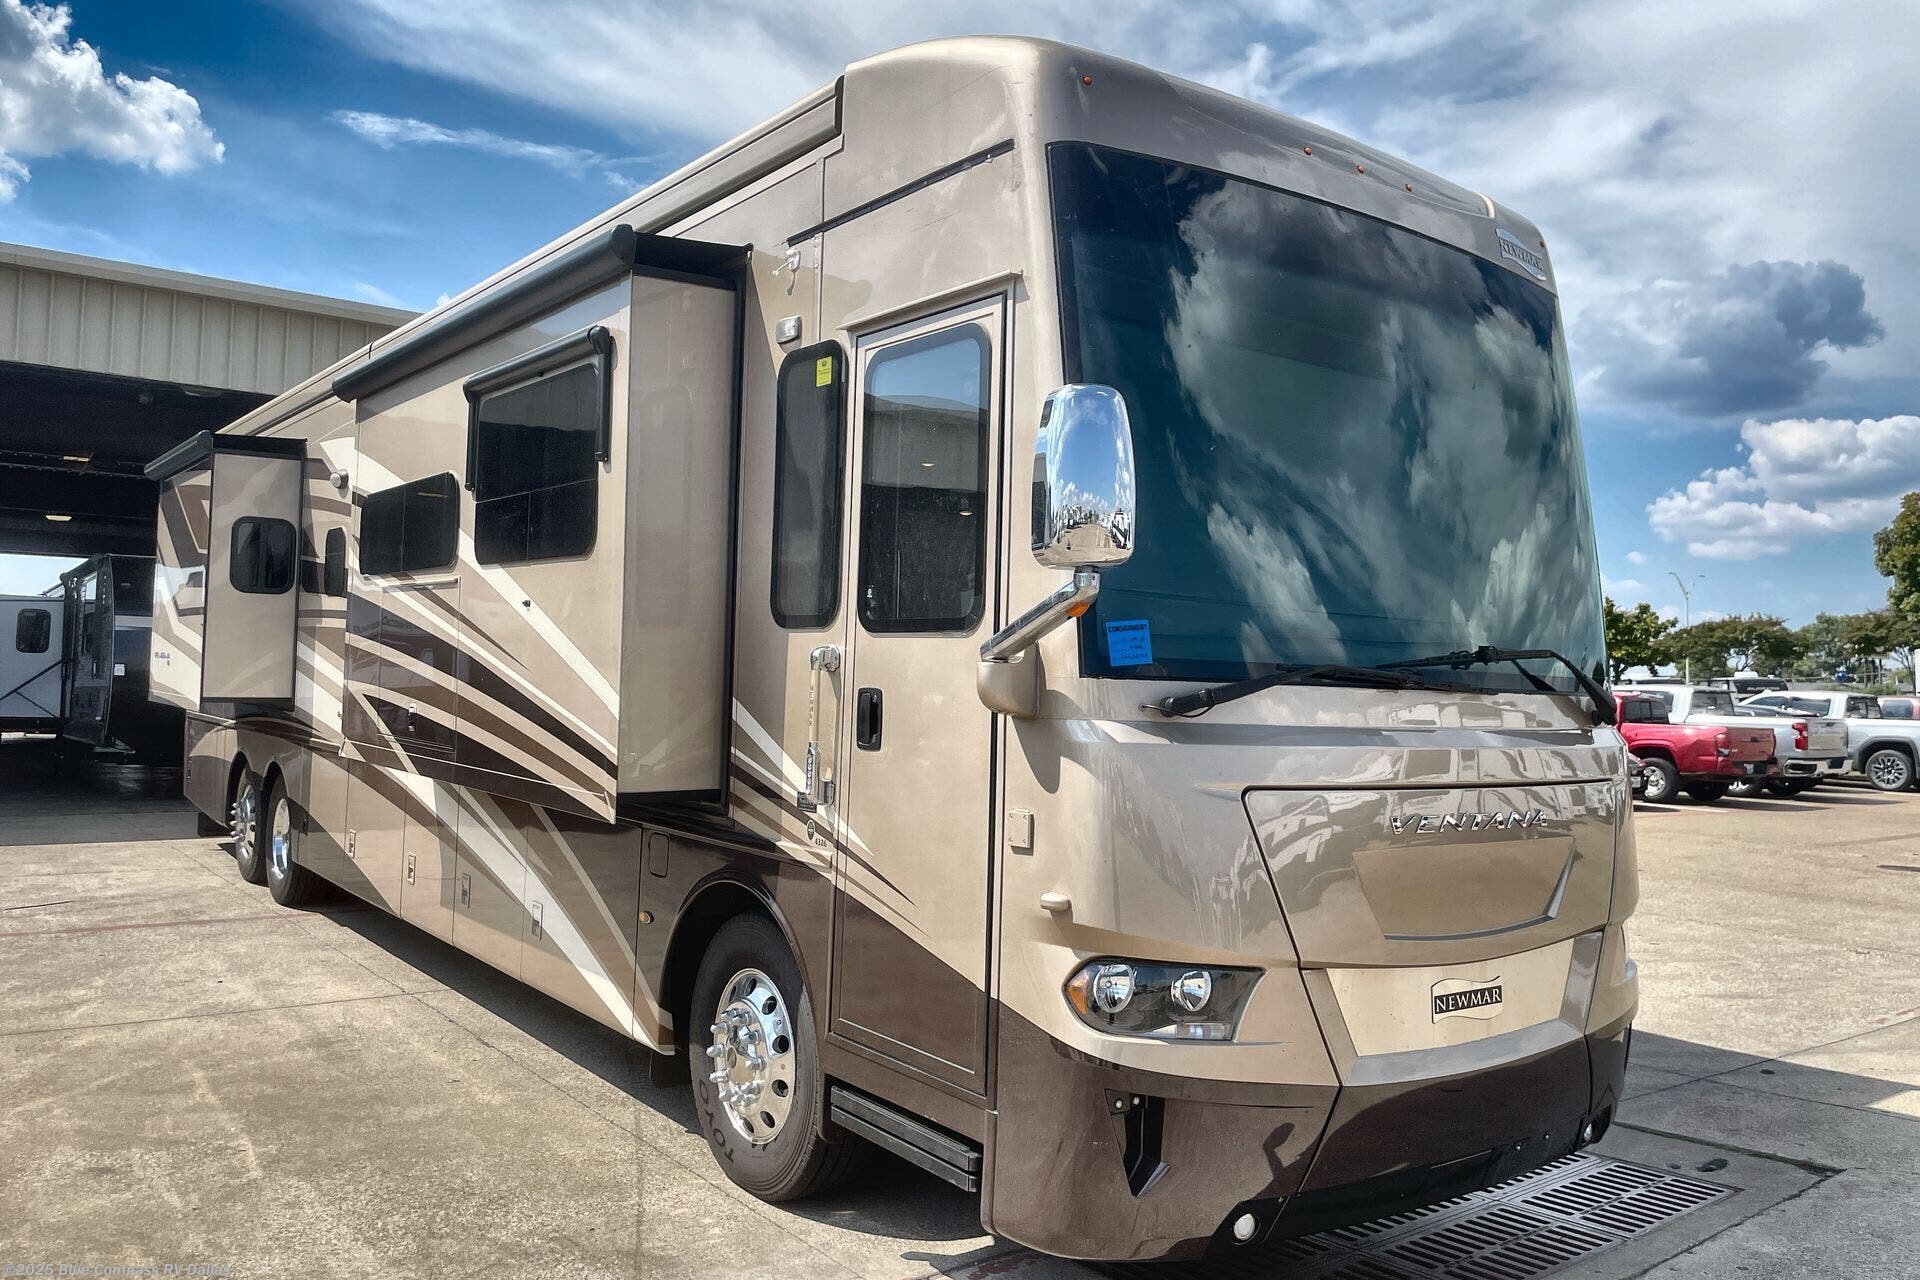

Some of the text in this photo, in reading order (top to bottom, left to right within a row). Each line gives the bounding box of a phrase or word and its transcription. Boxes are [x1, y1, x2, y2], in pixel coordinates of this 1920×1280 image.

[1499, 238, 1544, 272] NEWMAR
[1390, 808, 1548, 835] VENTANA
[1436, 988, 1501, 1012] NEWMAR
[699, 1079, 735, 1162] TOYO
